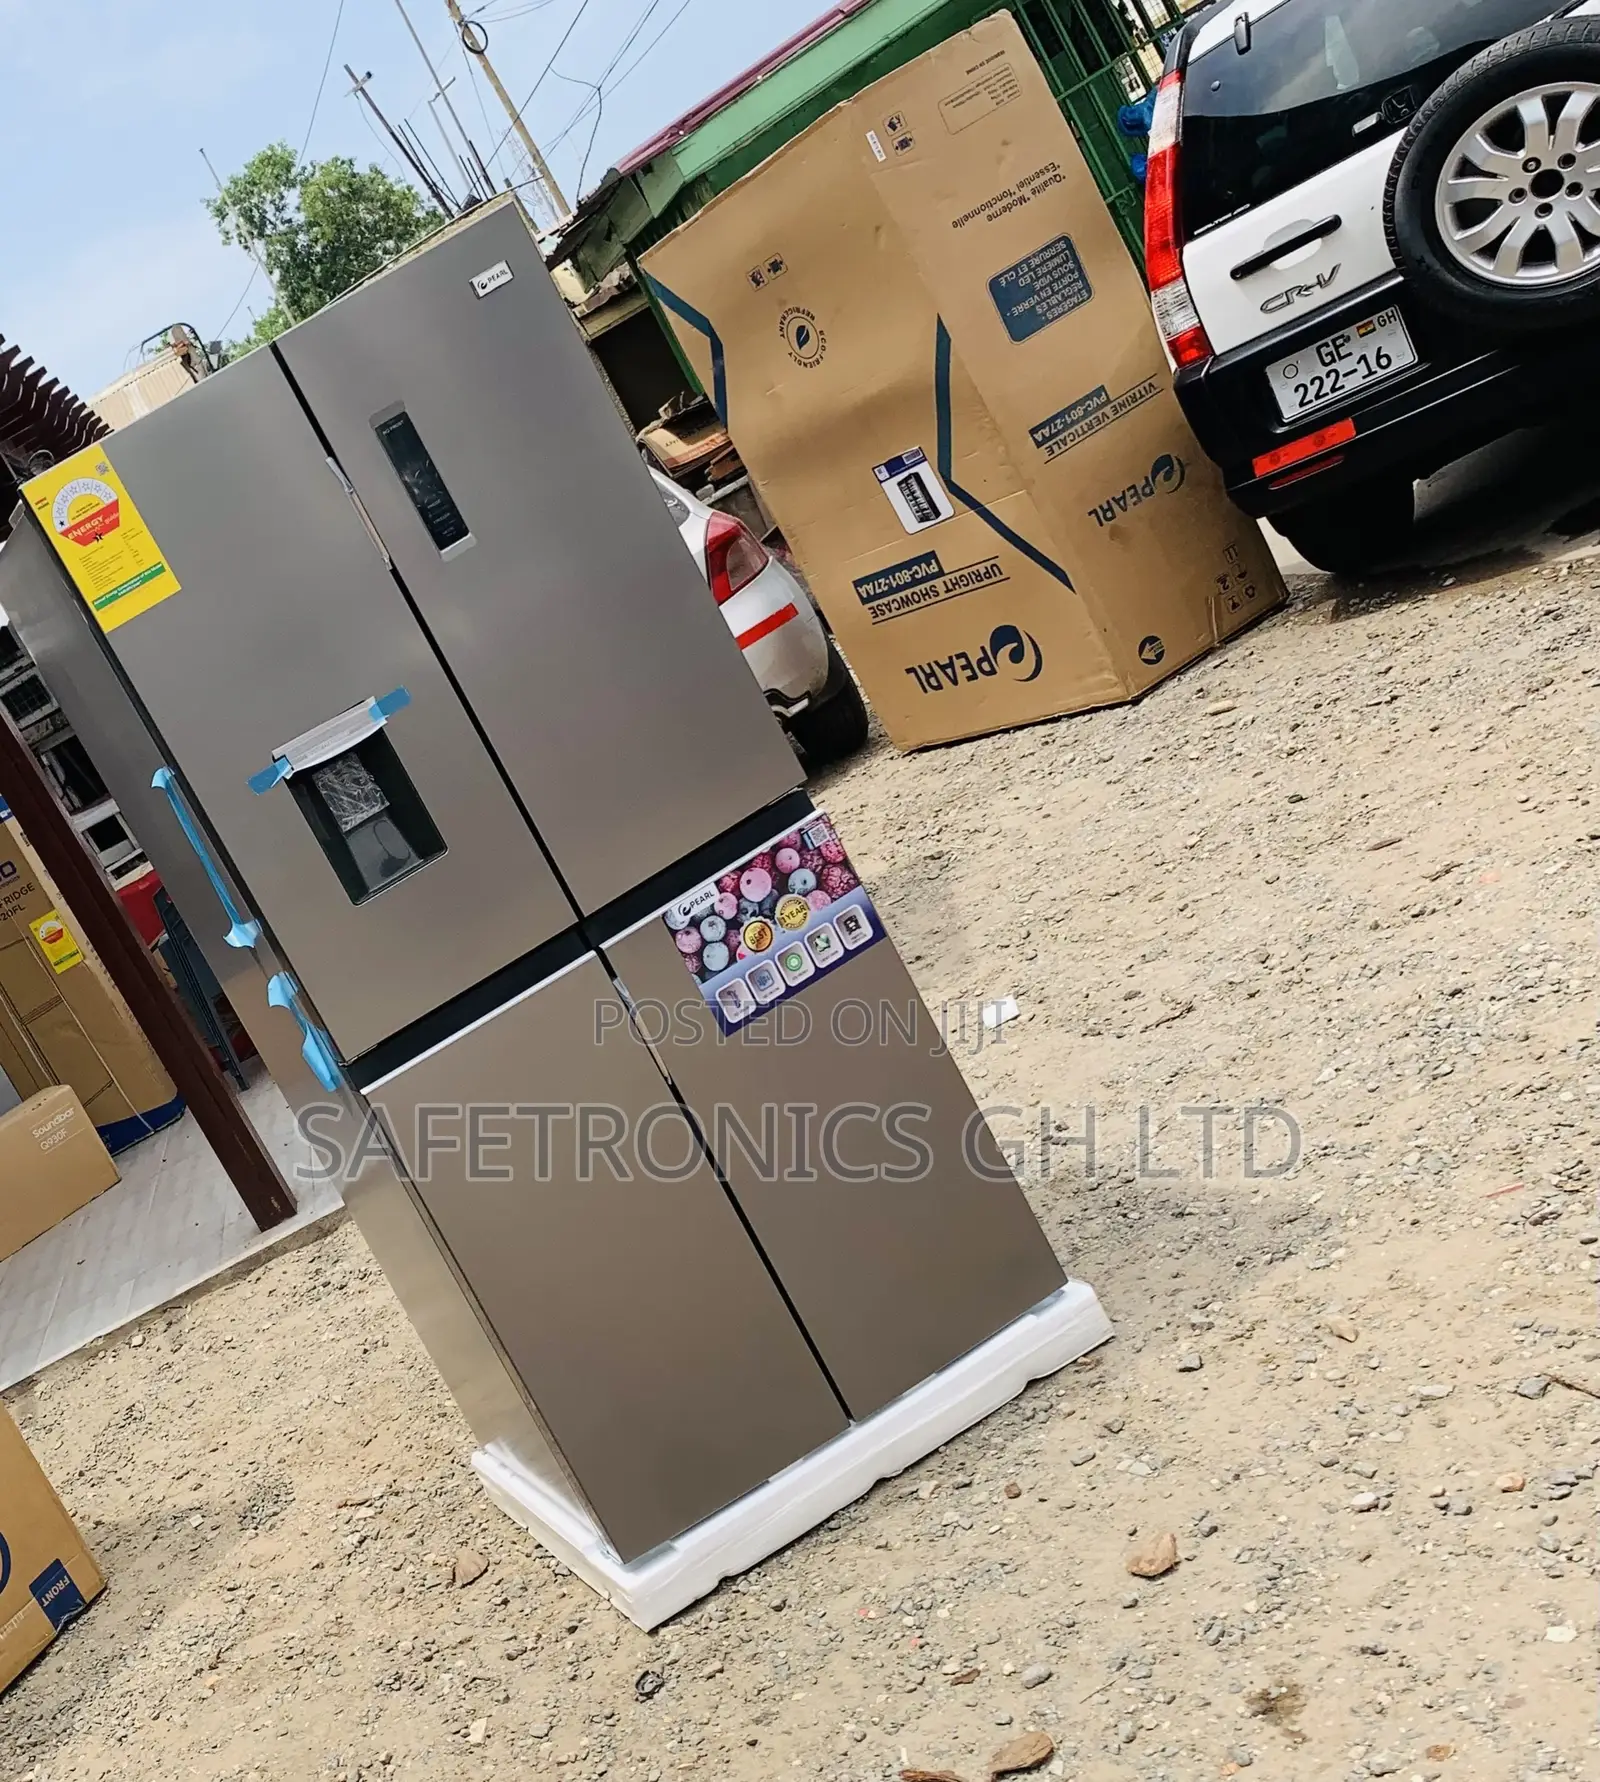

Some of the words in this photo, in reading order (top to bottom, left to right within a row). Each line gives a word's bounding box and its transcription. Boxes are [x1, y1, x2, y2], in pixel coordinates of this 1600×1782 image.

[1034, 240, 1067, 265] SERRURE
[487, 269, 508, 284] PEARL
[1016, 263, 1028, 273] ET
[1018, 271, 1037, 287] LED
[1053, 260, 1075, 279] SOUS
[1033, 273, 1053, 291] VIDE
[1040, 286, 1052, 300] EN
[1053, 271, 1079, 291] PORTE
[1011, 296, 1039, 317] VERRE
[1315, 334, 1354, 368] GE
[1376, 310, 1398, 328] GH
[1293, 346, 1393, 408] 222-16
[1111, 382, 1158, 415] VITRINE
[1033, 391, 1108, 442] PVC-801-27AA
[1044, 412, 1110, 457] VERTICALE
[1087, 475, 1155, 527] PEARL
[68, 516, 104, 540] ENERGY
[857, 559, 939, 598] PVC-801-27AA
[943, 562, 1003, 595] UPRIGHT
[868, 584, 940, 619] SHOWCASE
[904, 645, 998, 694] PEARL
[690, 889, 715, 909] PEARL
[749, 927, 768, 946] BEST
[32, 1107, 75, 1138] Soundbar
[40, 1128, 67, 1150] Q930F
[41, 1575, 70, 1607] FRONT
